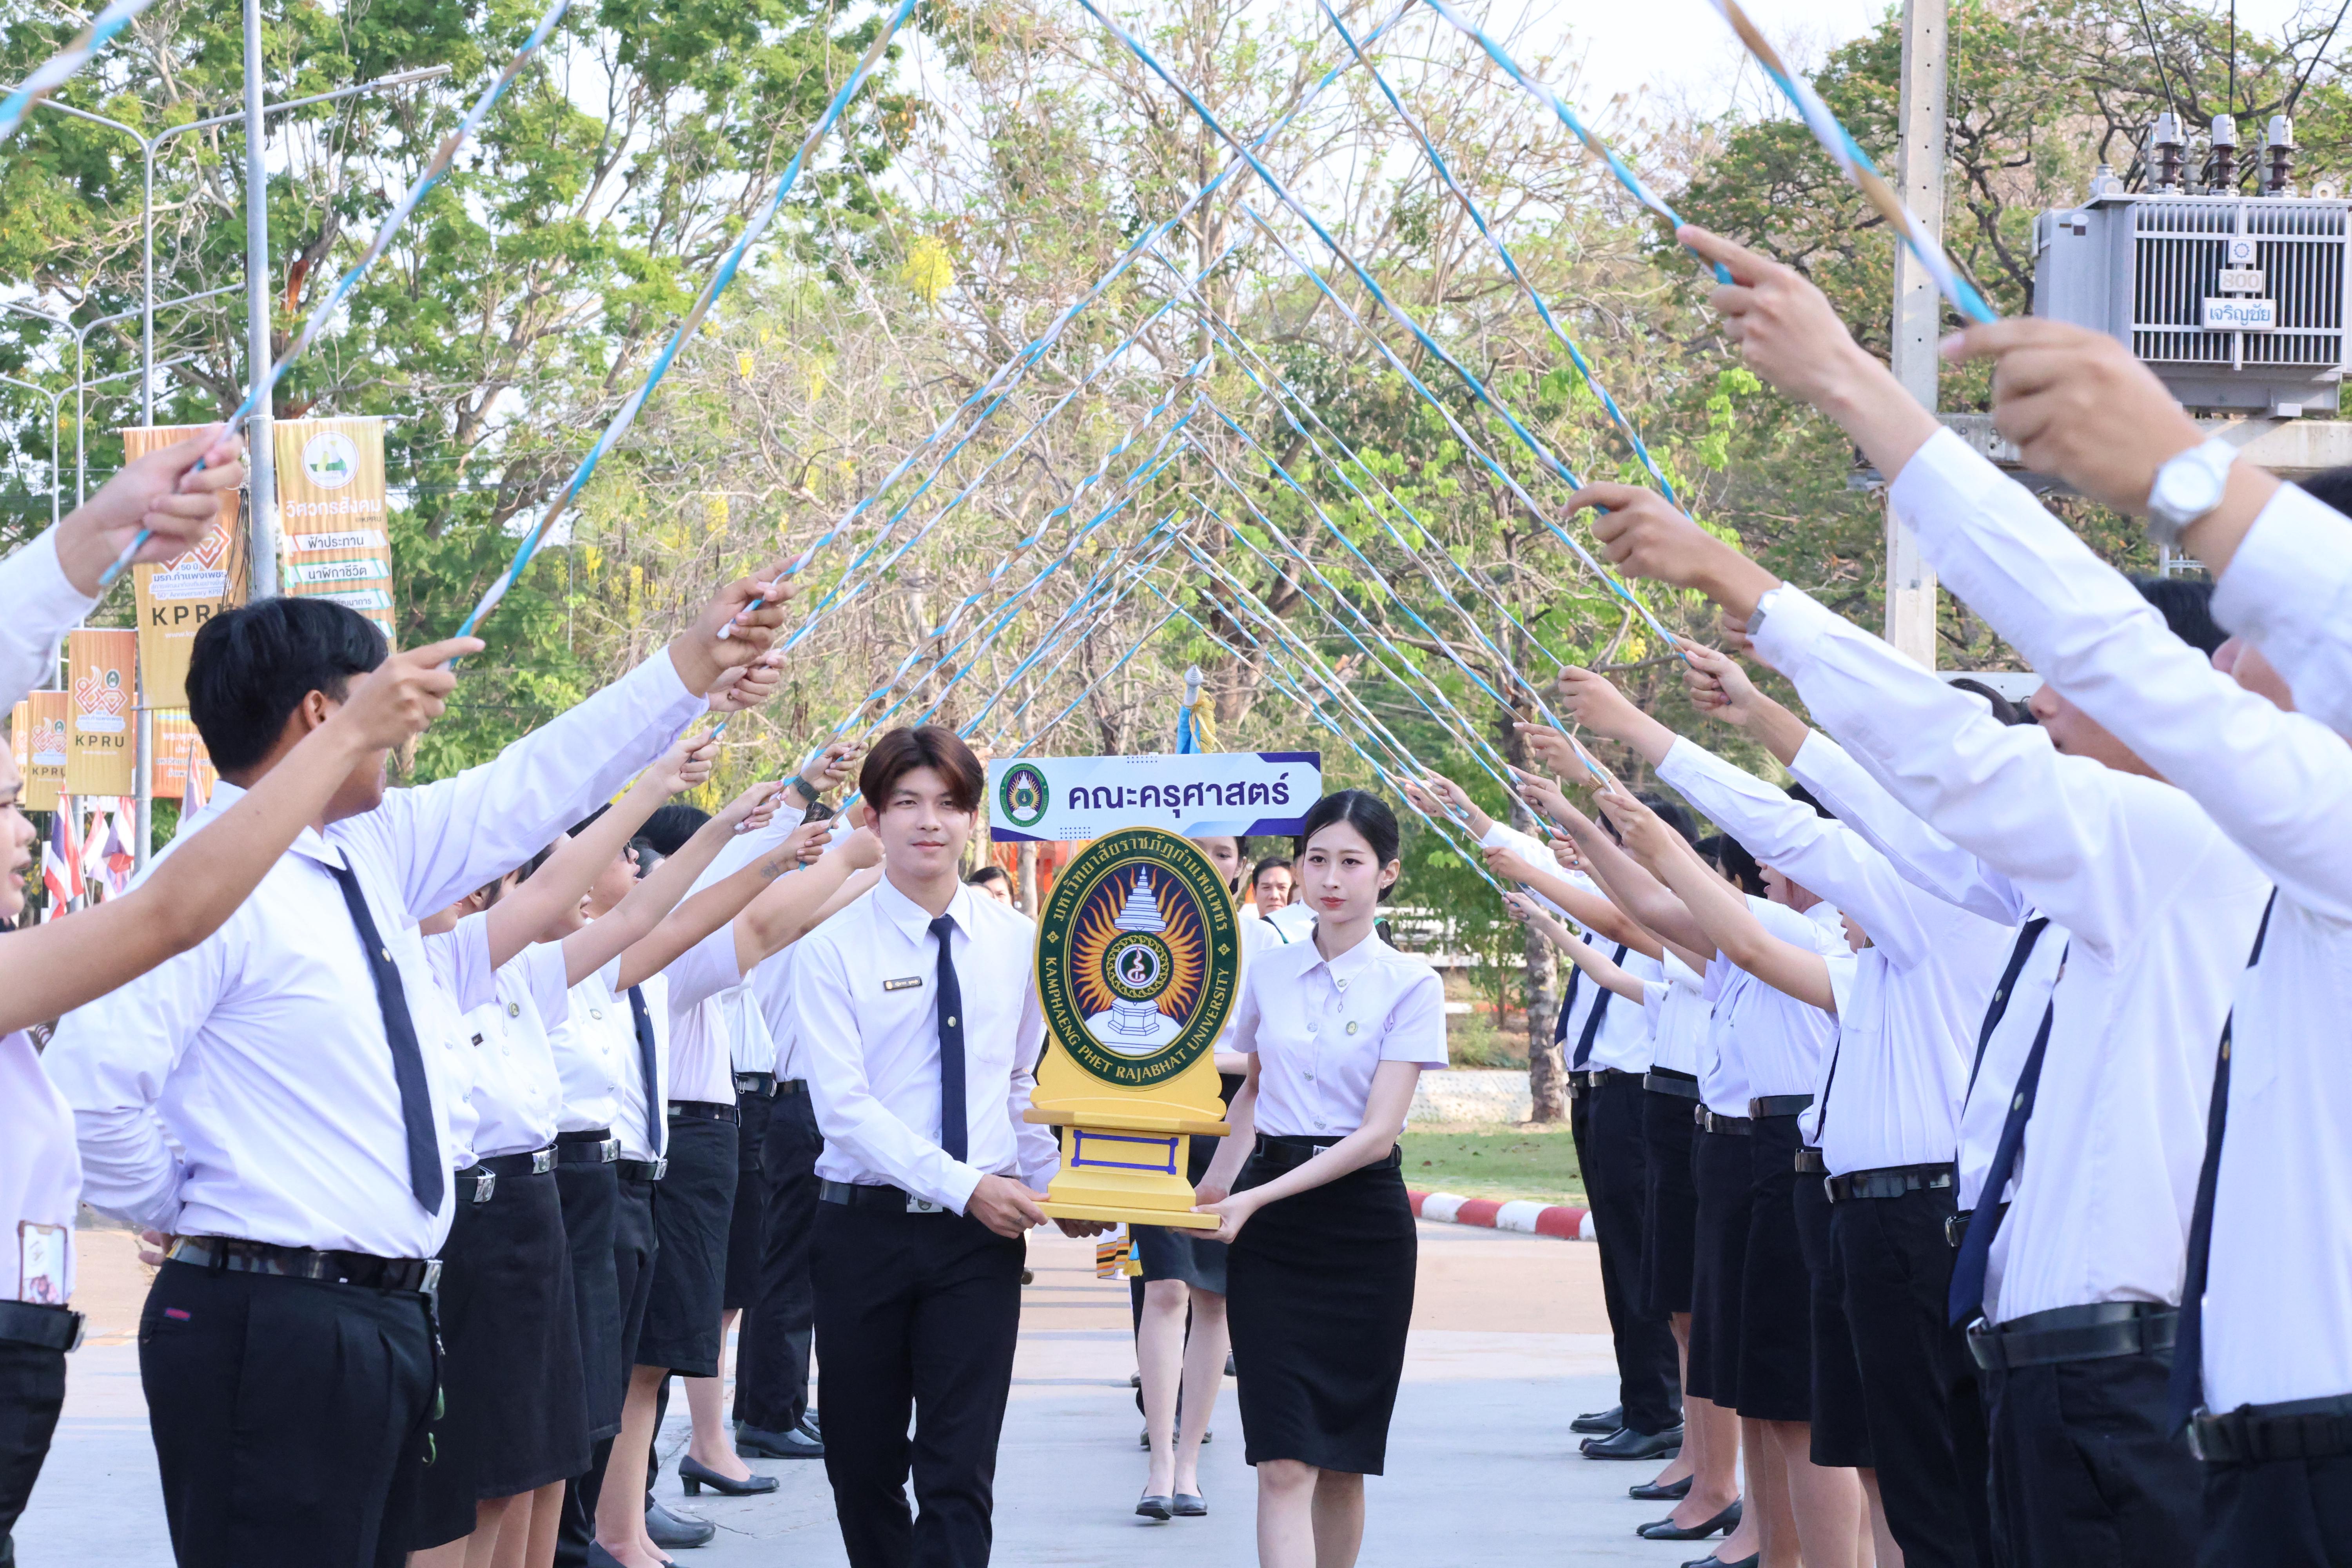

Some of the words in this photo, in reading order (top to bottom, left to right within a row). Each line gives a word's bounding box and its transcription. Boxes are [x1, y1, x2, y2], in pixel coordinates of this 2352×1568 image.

[2223, 273, 2260, 288] 800
[2210, 303, 2270, 326] เจริญชัย
[286, 496, 381, 518] วิศวกรสังคม
[308, 535, 364, 548] ฟ้าประทาน
[309, 564, 367, 580] นาฬิกาชีวิต
[76, 735, 124, 748] KPRU
[1068, 772, 1290, 818] คณะครุศาสตร์
[1053, 834, 1227, 932] มหาวิทยาลัยราชภัฏกำแพงเพชร
[1045, 957, 1080, 1046] KAMPHAENG
[1077, 1044, 1113, 1073] PHET
[1115, 1048, 1187, 1083] RAJABHAT
[1187, 967, 1229, 1051] UNIVERSITY
